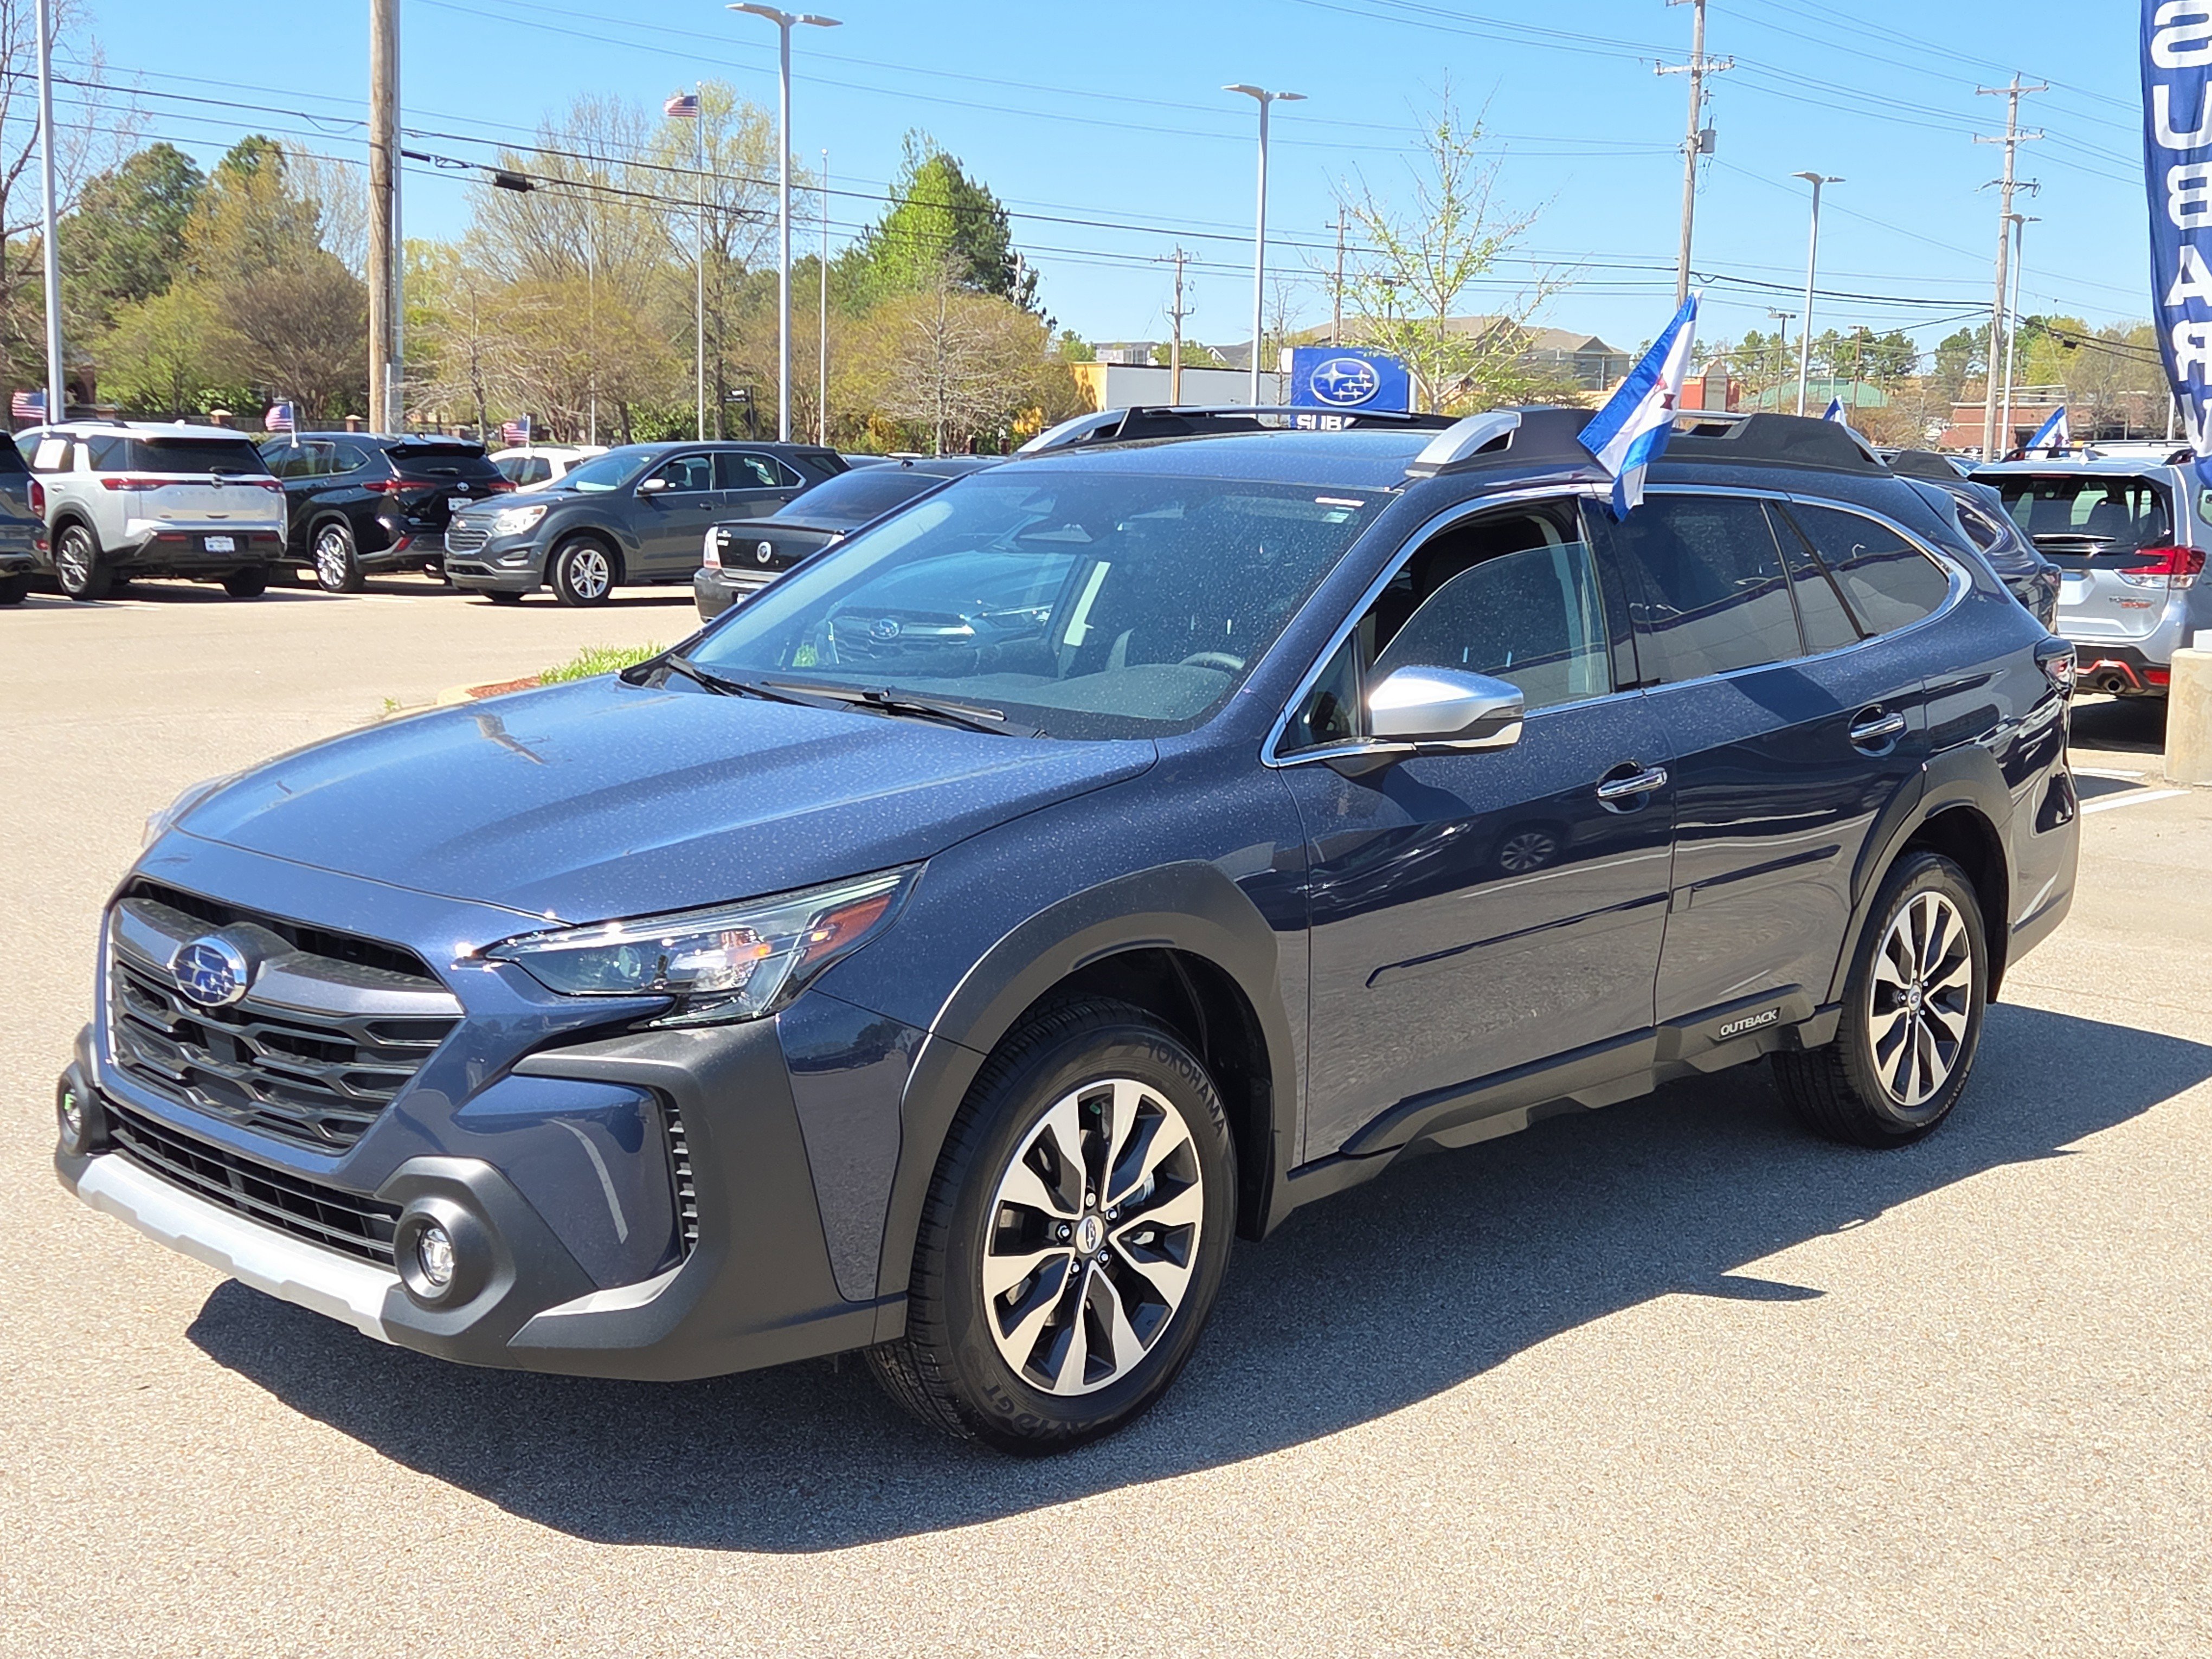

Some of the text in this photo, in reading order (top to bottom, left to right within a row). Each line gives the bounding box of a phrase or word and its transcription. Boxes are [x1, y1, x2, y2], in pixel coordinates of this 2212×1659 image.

[1720, 1009, 1777, 1036] OUTBACK
[1141, 1038, 1225, 1138] YOKOHAMA
[981, 1385, 1015, 1414] GT
